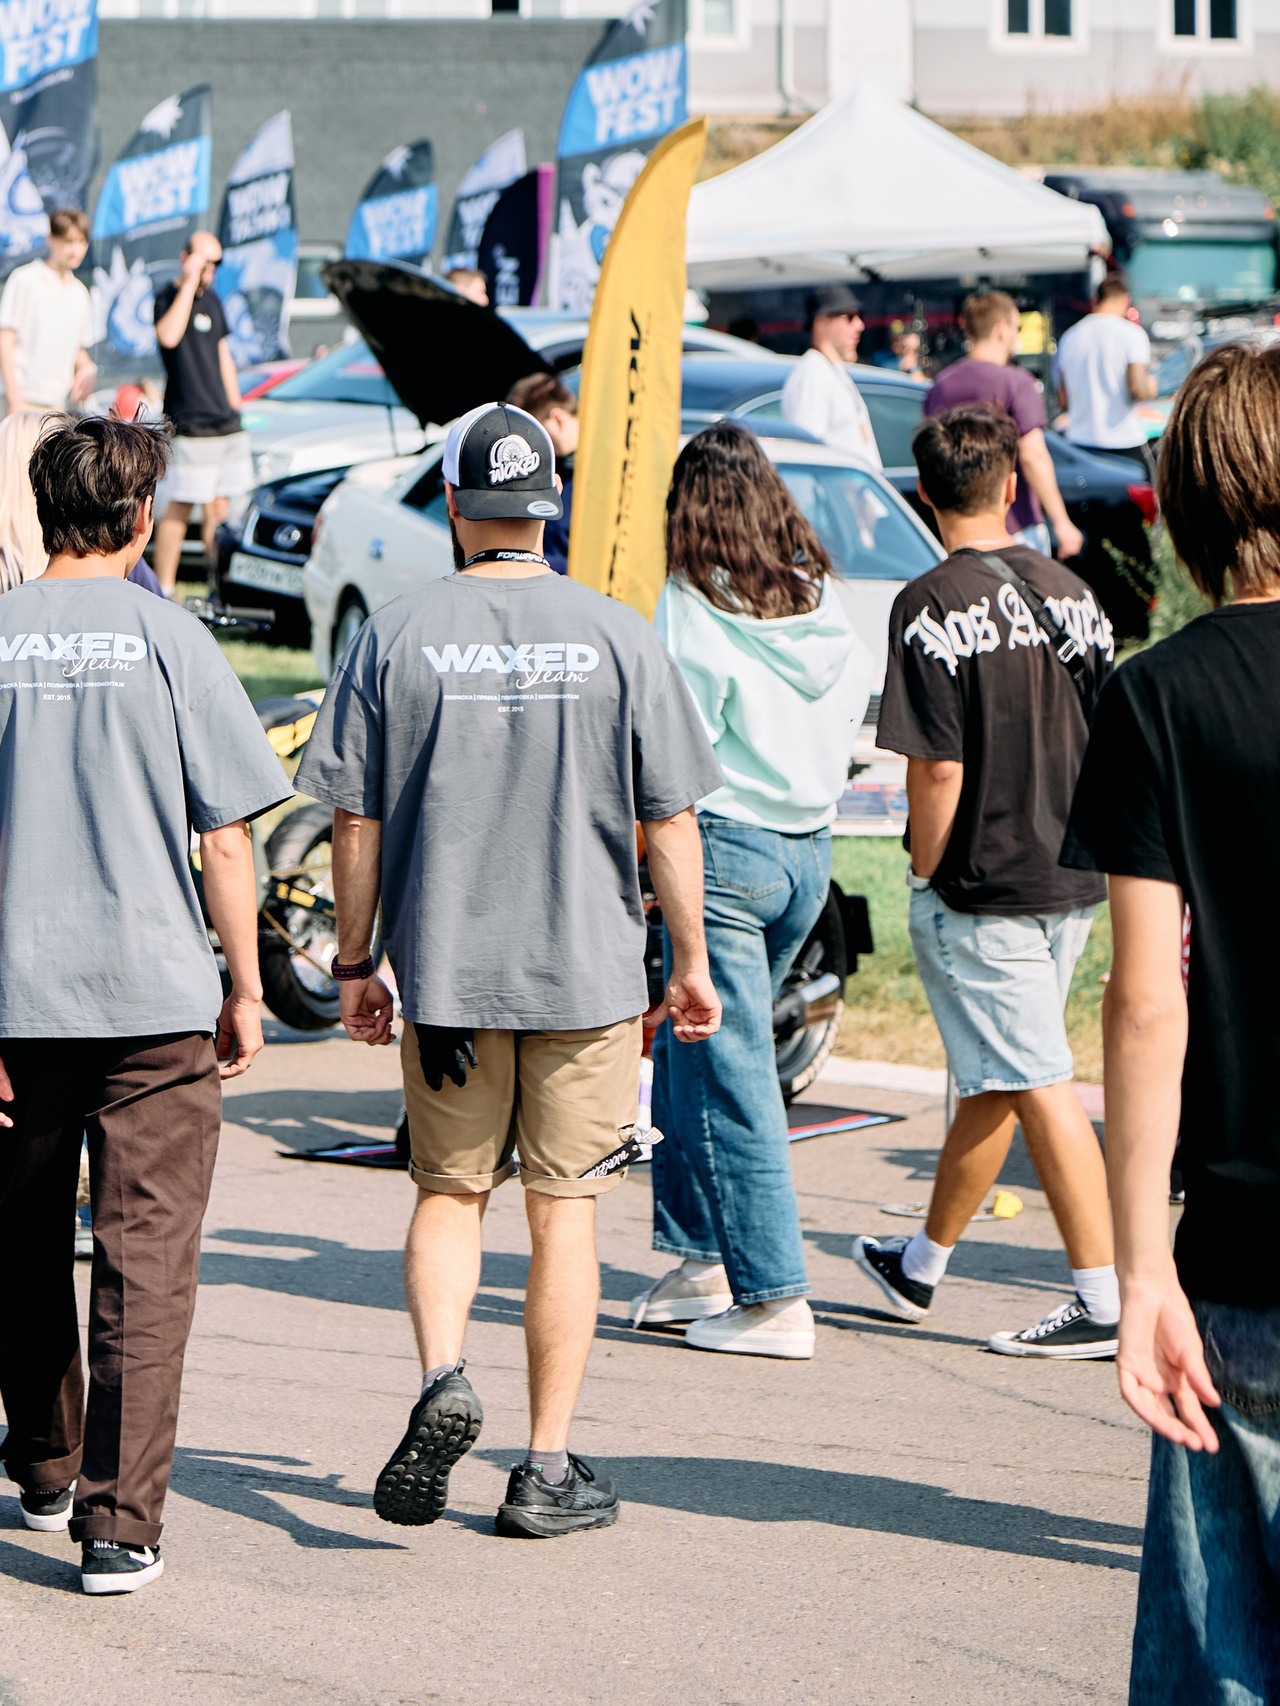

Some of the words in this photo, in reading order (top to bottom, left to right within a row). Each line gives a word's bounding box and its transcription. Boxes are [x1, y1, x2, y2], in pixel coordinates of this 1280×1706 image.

[596, 86, 681, 144] FEST
[496, 551, 543, 563] FORWARD
[56, 639, 135, 677] Team
[421, 643, 600, 673] WAXED
[512, 652, 589, 690] Team
[93, 1539, 119, 1549] NIKE
